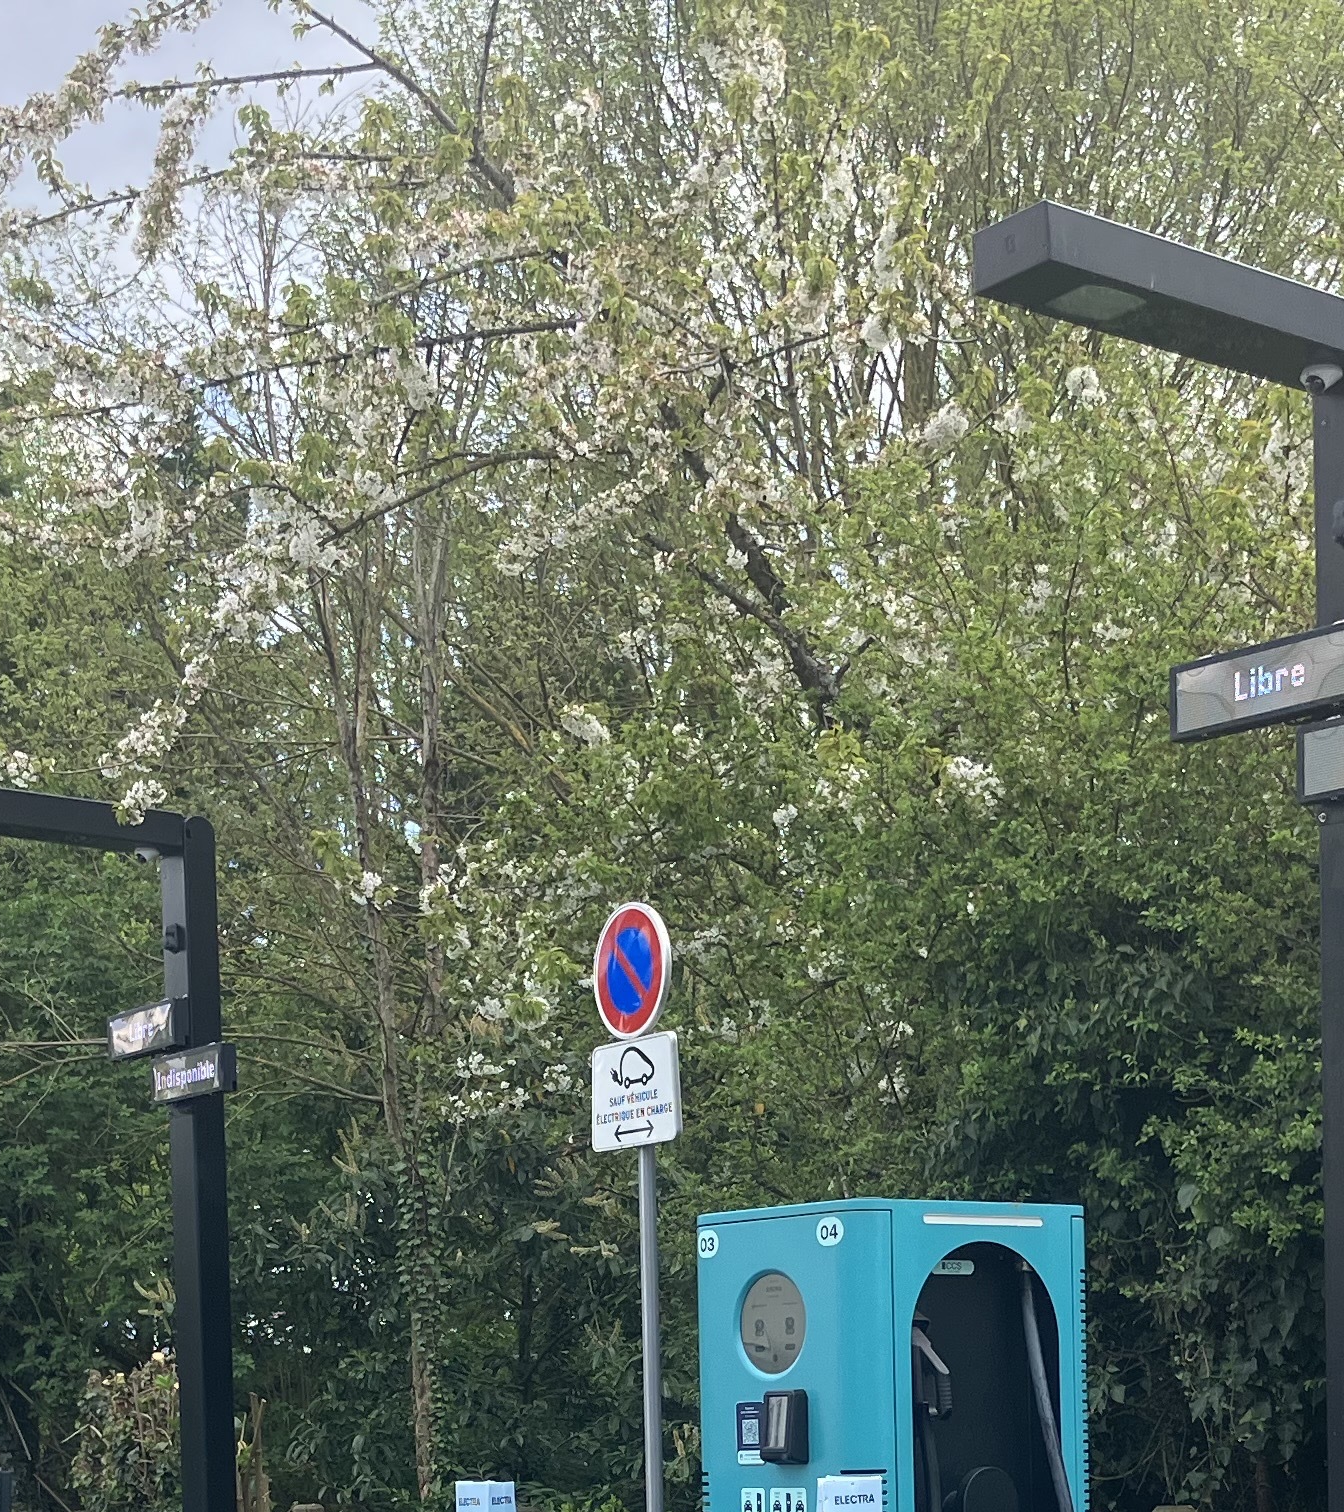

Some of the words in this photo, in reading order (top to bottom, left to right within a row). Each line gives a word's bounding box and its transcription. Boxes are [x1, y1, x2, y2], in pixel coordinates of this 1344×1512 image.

[1234, 662, 1305, 701] Libre
[129, 1022, 154, 1042] Libre
[157, 1060, 215, 1090] Indisponible
[609, 1095, 625, 1107] SAUF
[627, 1088, 658, 1104] VÉHICULE
[596, 1109, 634, 1125] ÉLECTRIQUE
[636, 1107, 645, 1118] EN
[646, 1101, 673, 1116] CHARGE
[820, 1224, 838, 1240] 04
[700, 1237, 715, 1253] 03
[834, 1494, 875, 1505] ELECTRA
